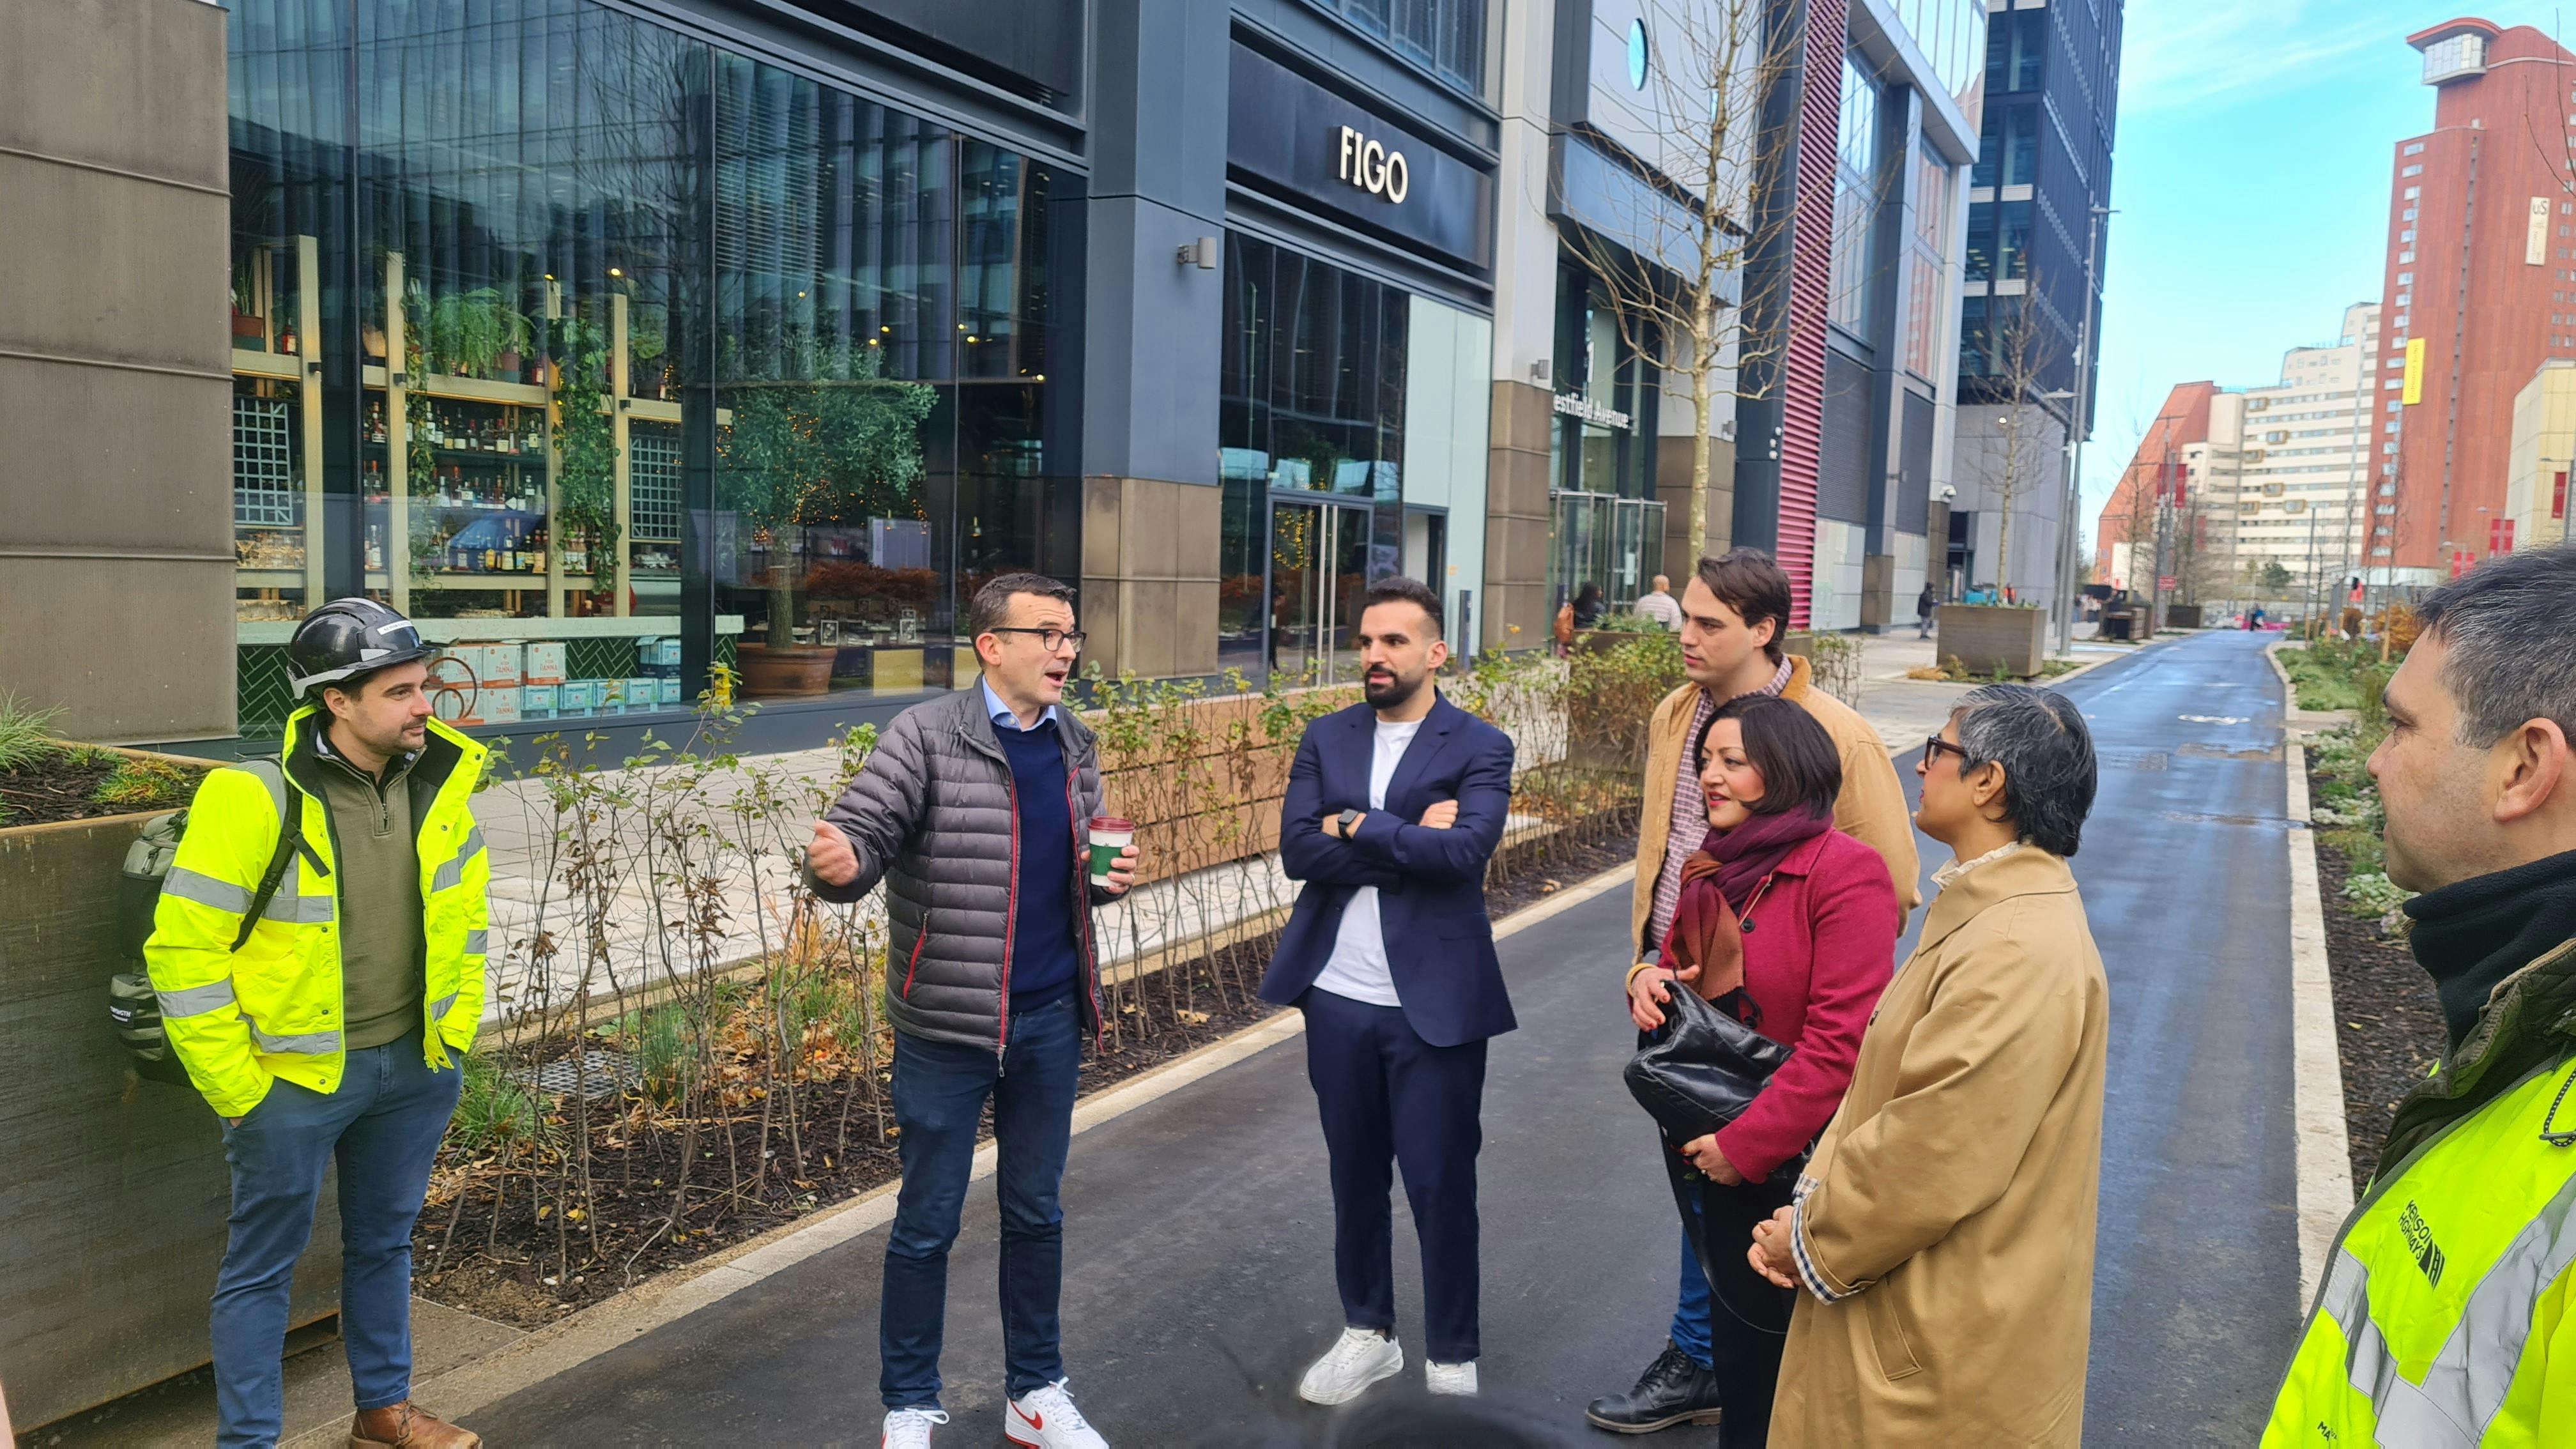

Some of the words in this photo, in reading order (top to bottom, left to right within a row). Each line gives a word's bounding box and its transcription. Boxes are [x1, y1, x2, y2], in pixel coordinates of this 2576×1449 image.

[1340, 125, 1408, 204] FIGO
[1552, 390, 1593, 420] estfield
[1594, 400, 1629, 429] Avenue
